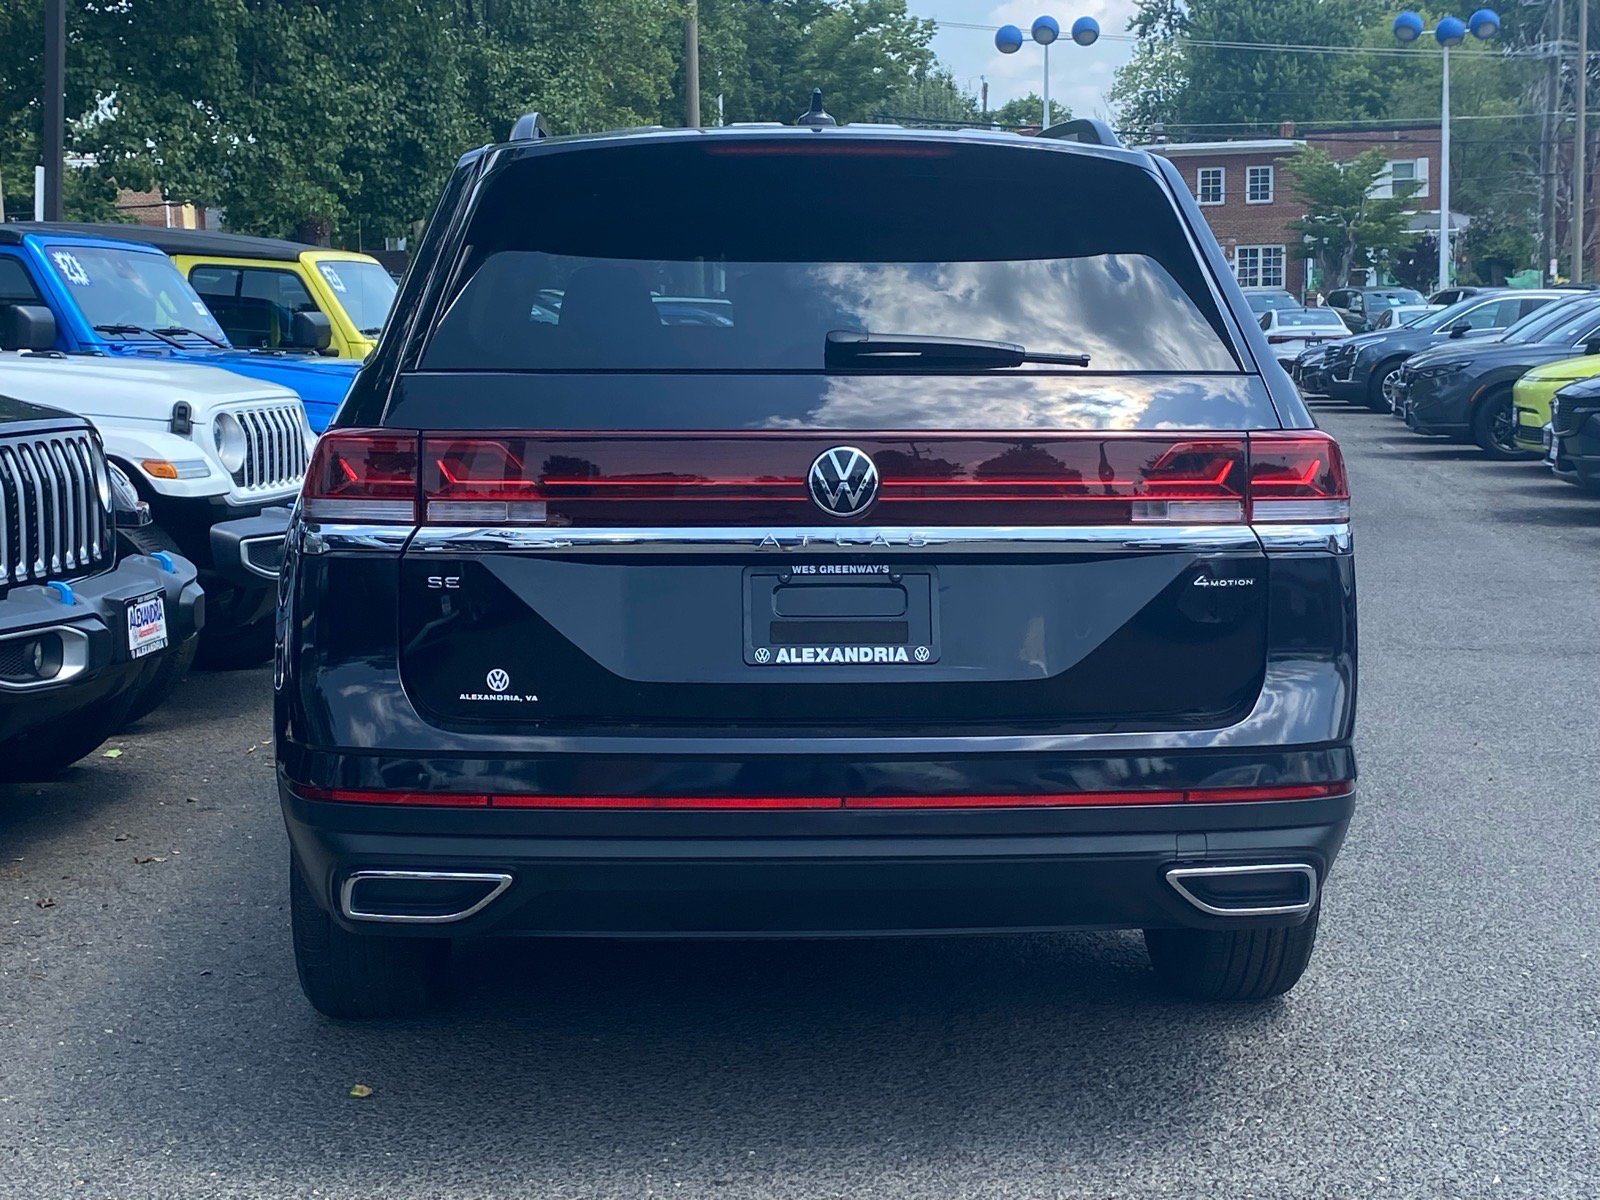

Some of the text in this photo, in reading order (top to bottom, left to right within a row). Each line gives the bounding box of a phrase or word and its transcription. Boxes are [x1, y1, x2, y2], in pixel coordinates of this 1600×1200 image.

[758, 532, 928, 549] ATLAS
[791, 564, 890, 575] WES GREENWAY'S
[427, 576, 460, 589] SE
[1193, 575, 1255, 587] 4MOTION
[775, 646, 909, 663] ALEXANDRIA
[459, 693, 523, 703] ALEXANDRIA,
